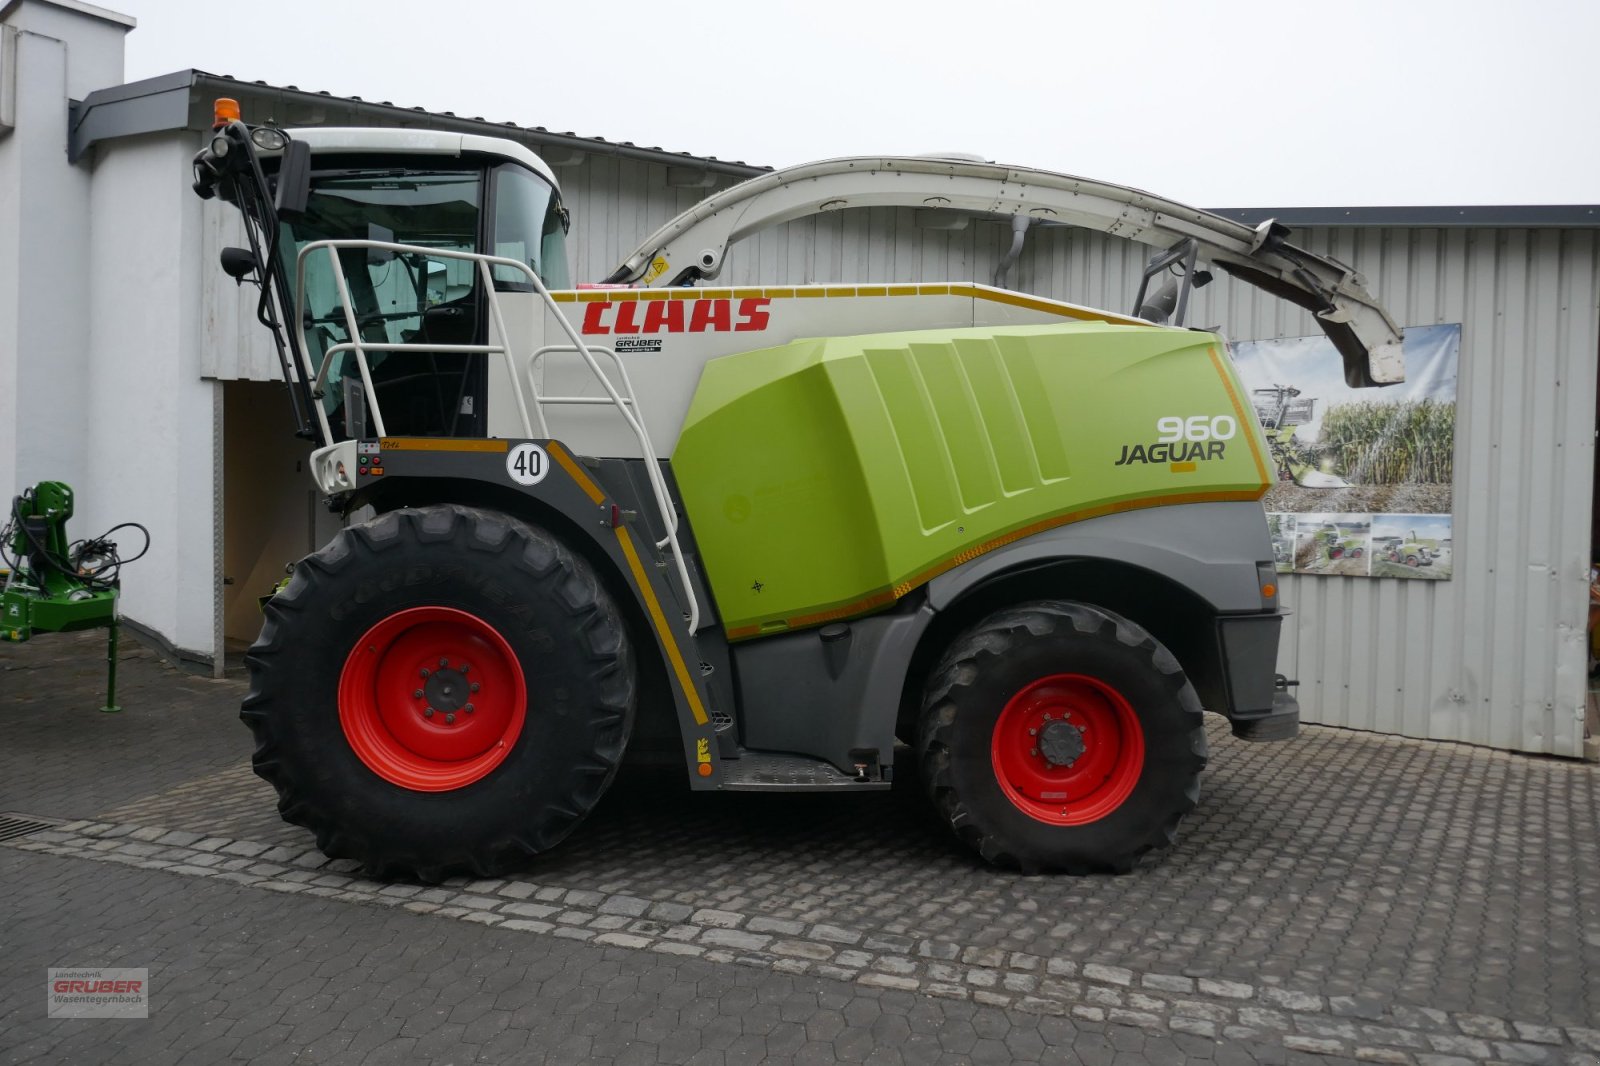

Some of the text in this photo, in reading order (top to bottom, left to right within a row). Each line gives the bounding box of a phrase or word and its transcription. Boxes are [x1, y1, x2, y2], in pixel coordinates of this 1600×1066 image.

[581, 298, 771, 334] CLAAS
[1157, 415, 1236, 443] 960
[513, 450, 541, 476] 40
[1114, 440, 1225, 466] JAGUAR
